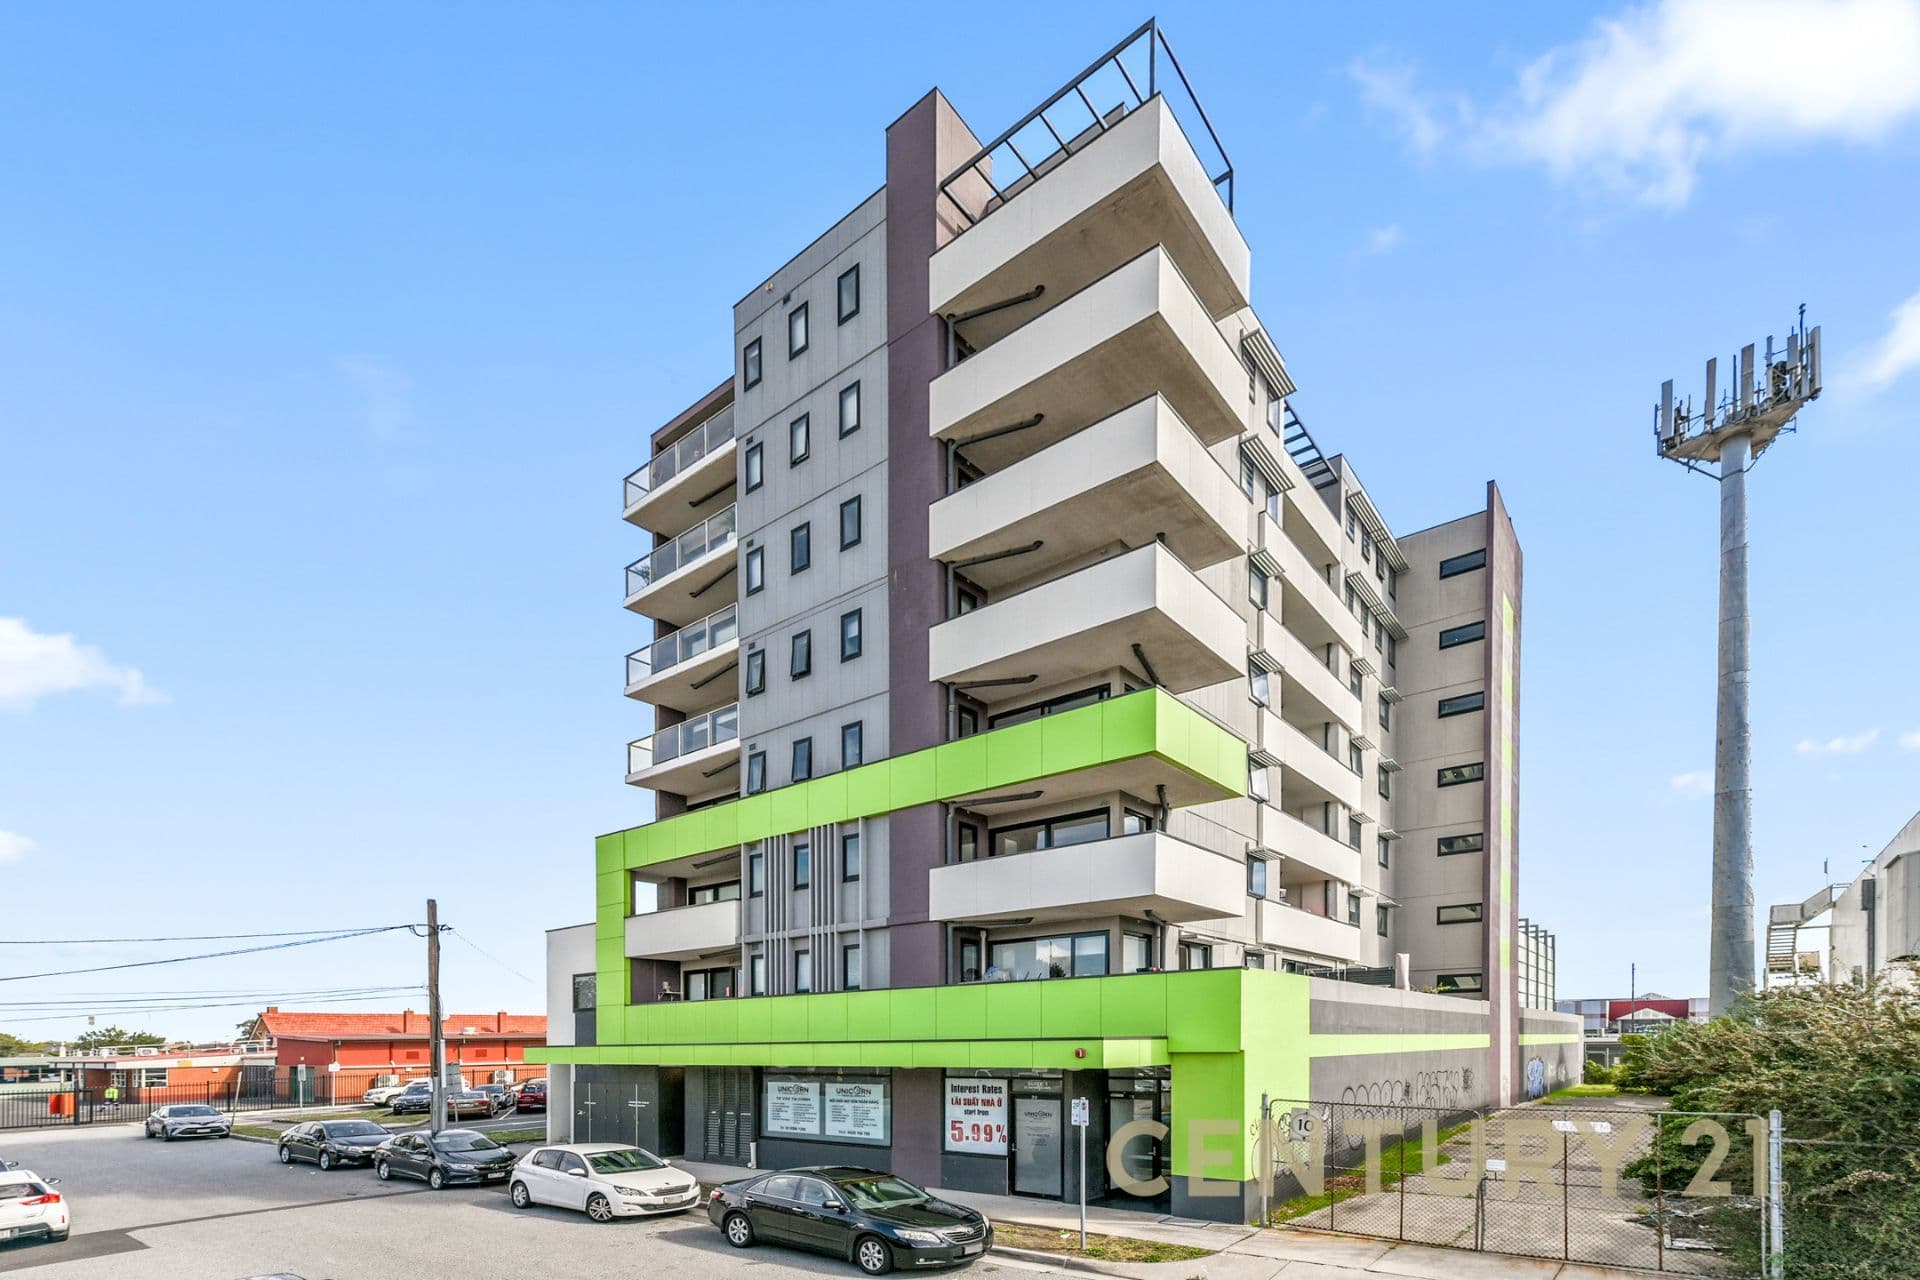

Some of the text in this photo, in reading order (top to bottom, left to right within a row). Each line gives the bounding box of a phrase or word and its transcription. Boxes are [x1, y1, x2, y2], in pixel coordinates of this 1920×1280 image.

[777, 1084, 809, 1093] UNICORN
[835, 1085, 872, 1095] UNICORN
[951, 1084, 1002, 1094] Interest Rates
[951, 1120, 1007, 1143] 5.99%
